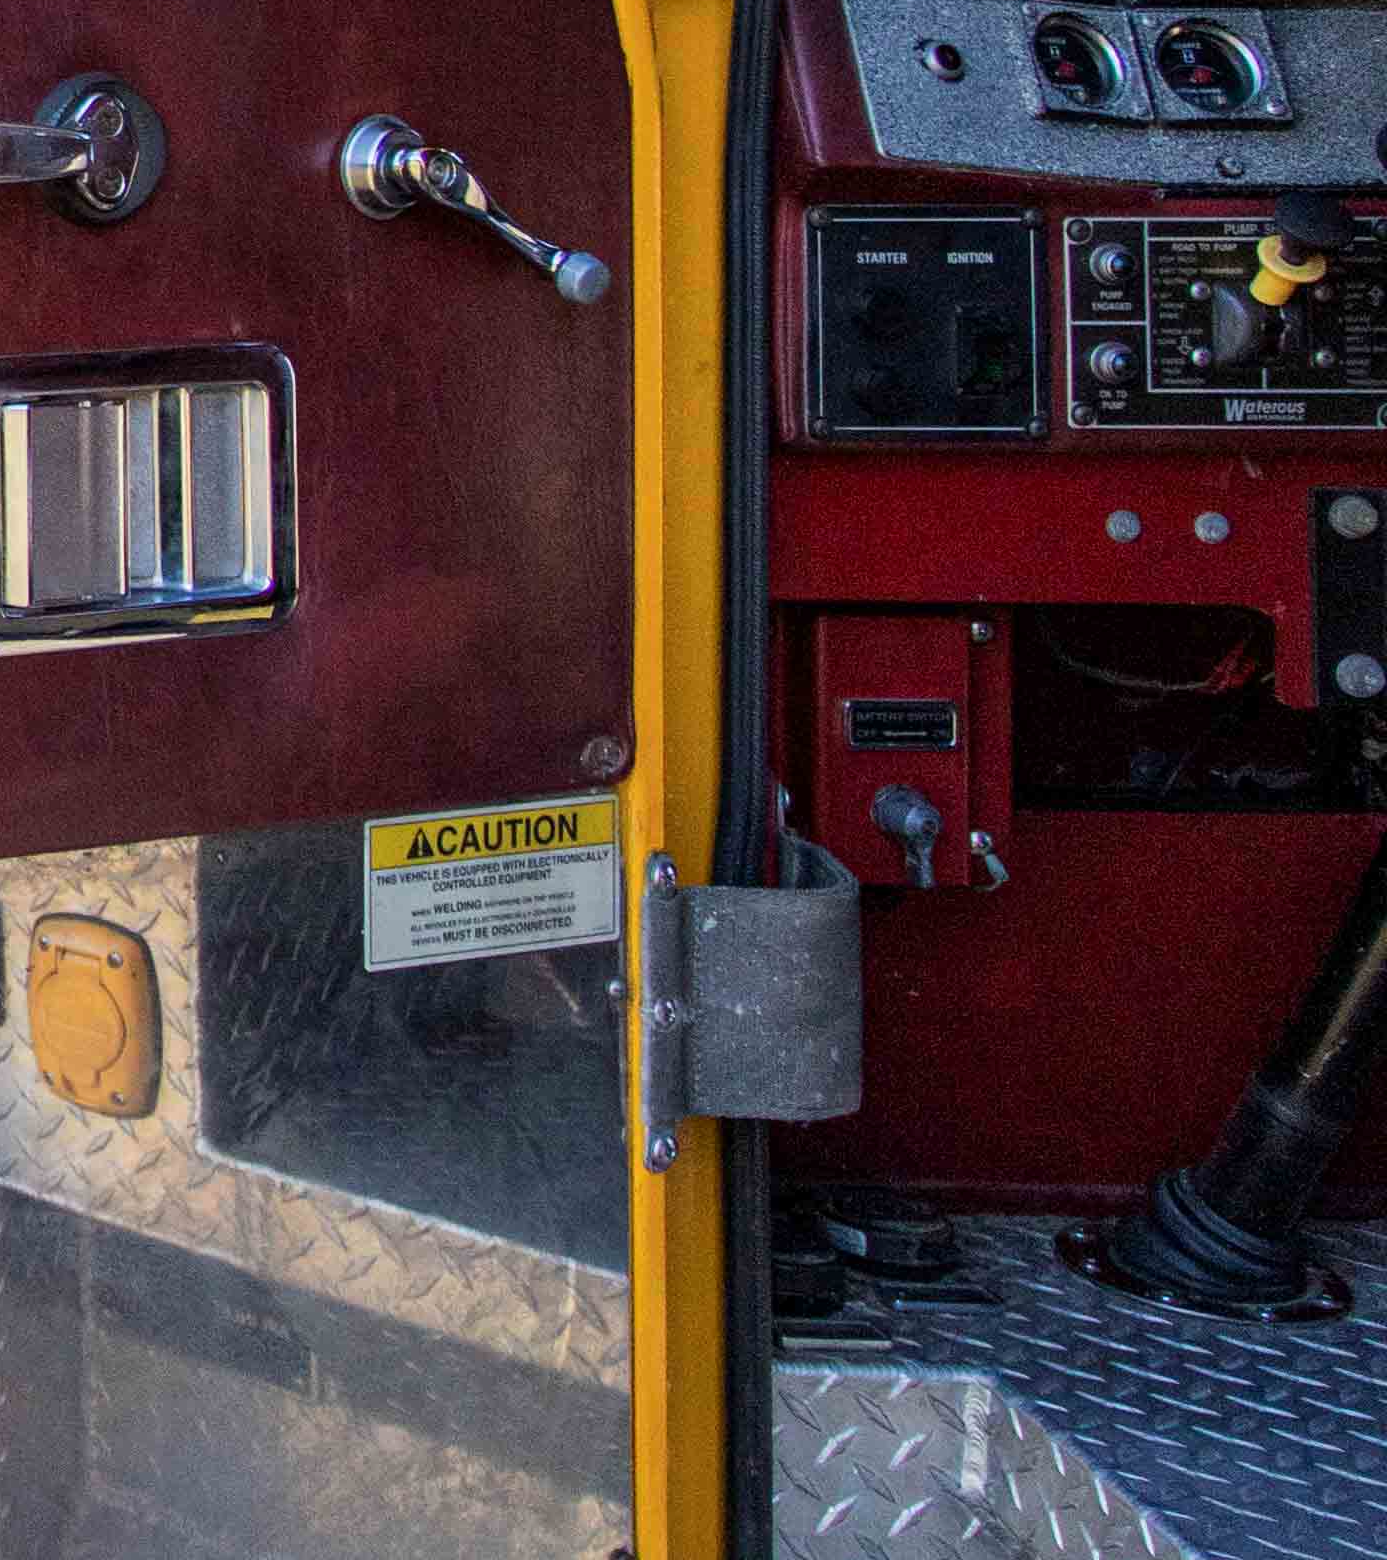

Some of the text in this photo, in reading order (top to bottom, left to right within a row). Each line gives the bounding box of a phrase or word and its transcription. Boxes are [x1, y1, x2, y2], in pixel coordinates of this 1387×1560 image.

[1223, 224, 1258, 235] PUMP
[856, 252, 994, 264] STARTER IGNITION
[1224, 399, 1305, 422] Waterous
[436, 813, 577, 856] CAUTION
[377, 849, 610, 886] THIS VEHICLE IS EQUIPPED WITH ELECTRONICALLY
[432, 875, 497, 893] CONTROLLED
[433, 899, 482, 914] WELDING
[443, 929, 473, 943] MUST
[475, 927, 490, 939] BE
